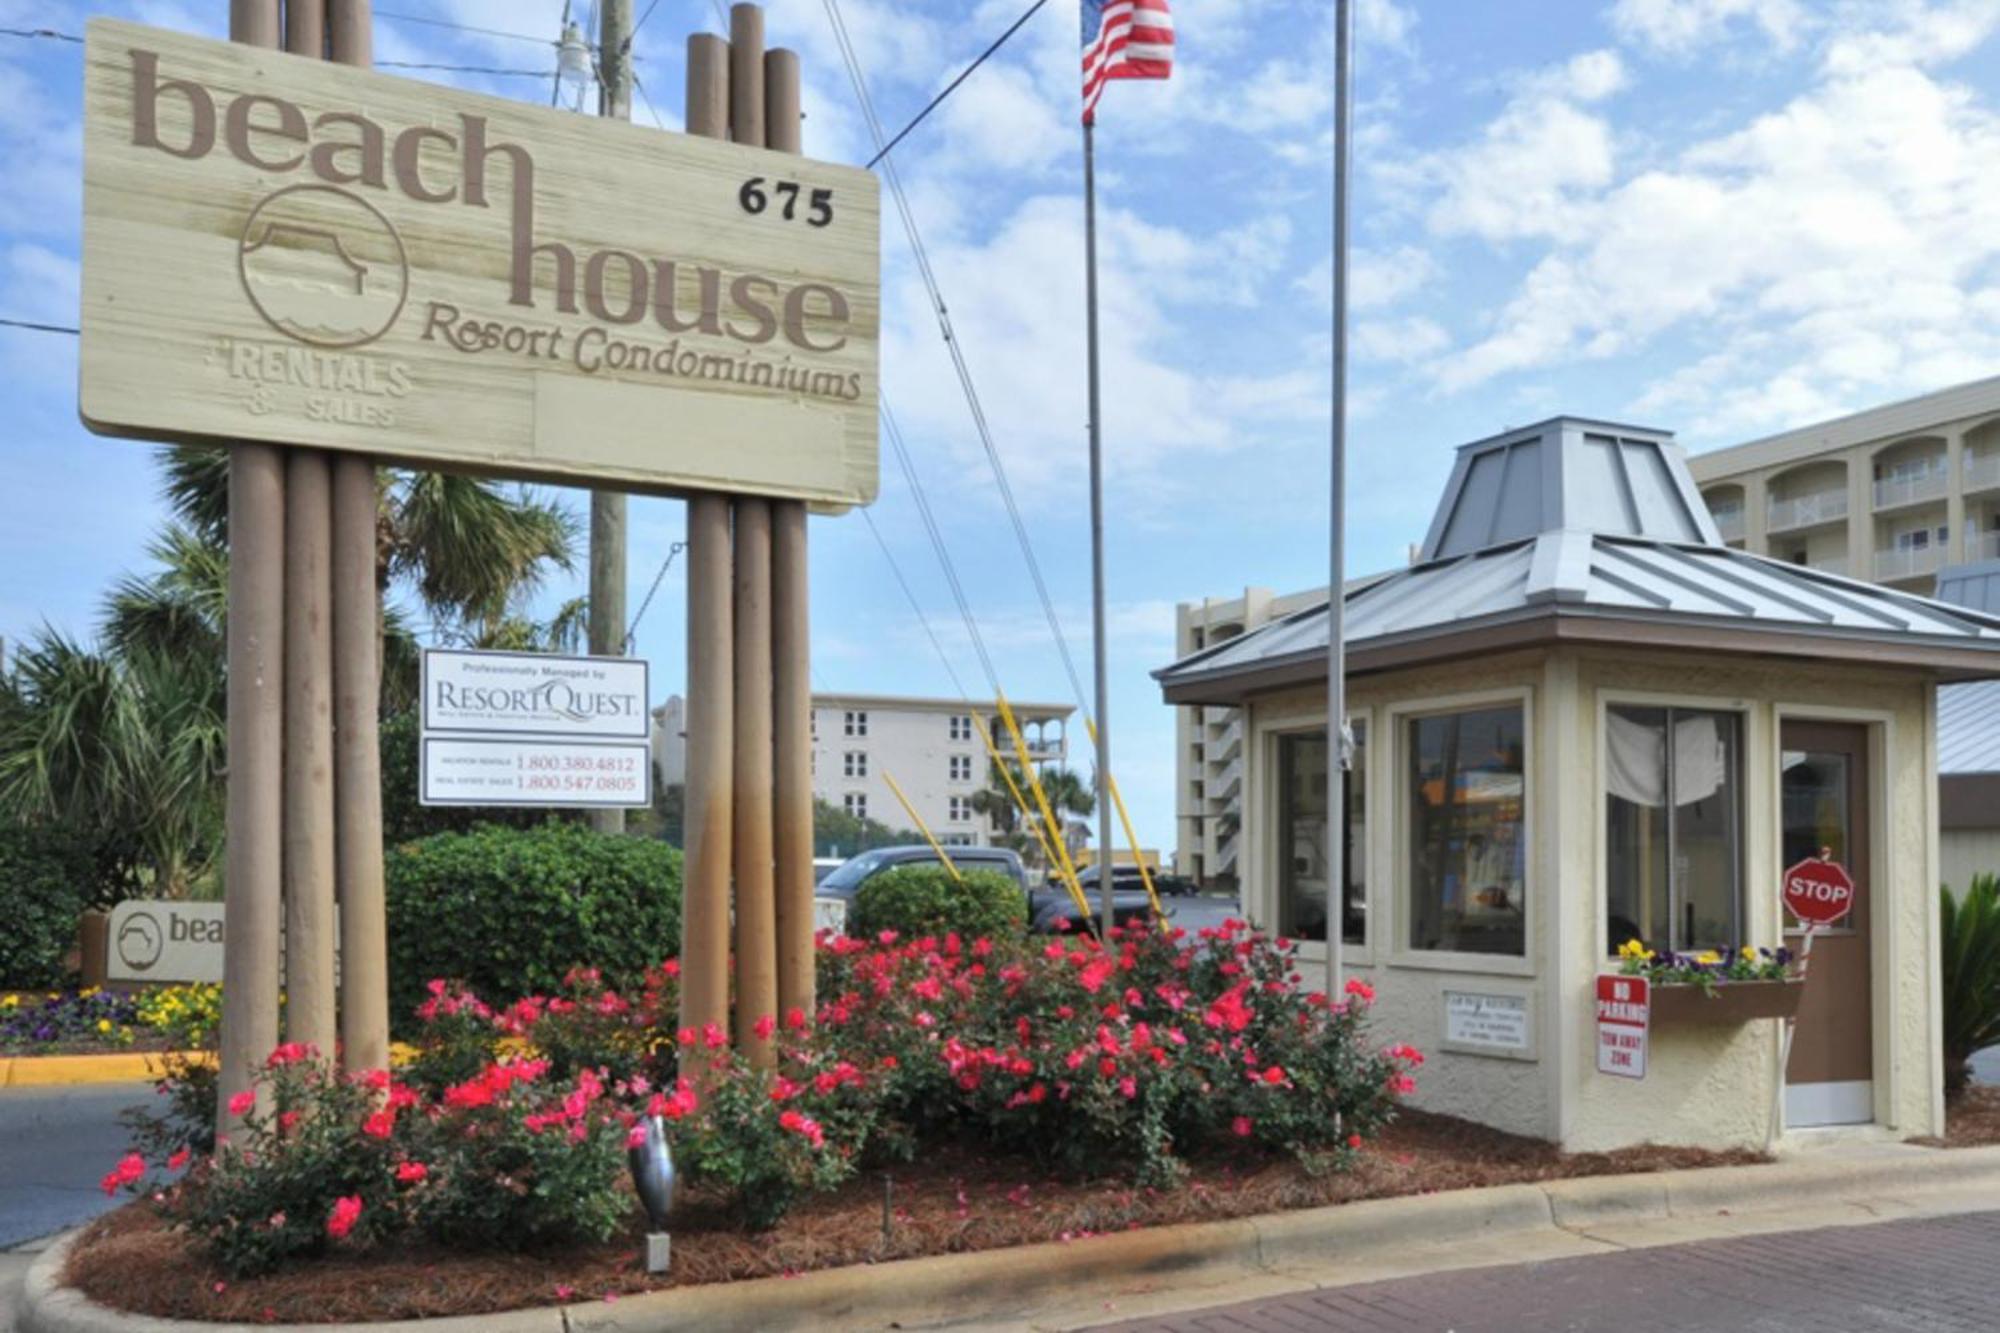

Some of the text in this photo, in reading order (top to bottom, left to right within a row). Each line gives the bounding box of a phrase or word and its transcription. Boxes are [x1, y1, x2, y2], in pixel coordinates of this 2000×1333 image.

[128, 48, 533, 207] beach
[738, 177, 835, 228] 675
[509, 200, 849, 352] house
[421, 301, 861, 401] Resort Condominiums
[230, 340, 412, 398] RENTALS
[303, 395, 397, 429] SALES
[462, 662, 538, 677] Professionally
[541, 666, 590, 680] Managed
[1789, 877, 1849, 904] STOP
[1613, 980, 1631, 1001] NO
[1599, 999, 1650, 1021] PARKING
[1601, 1031, 1618, 1047] TOW
[1610, 1050, 1632, 1067] ZONE
